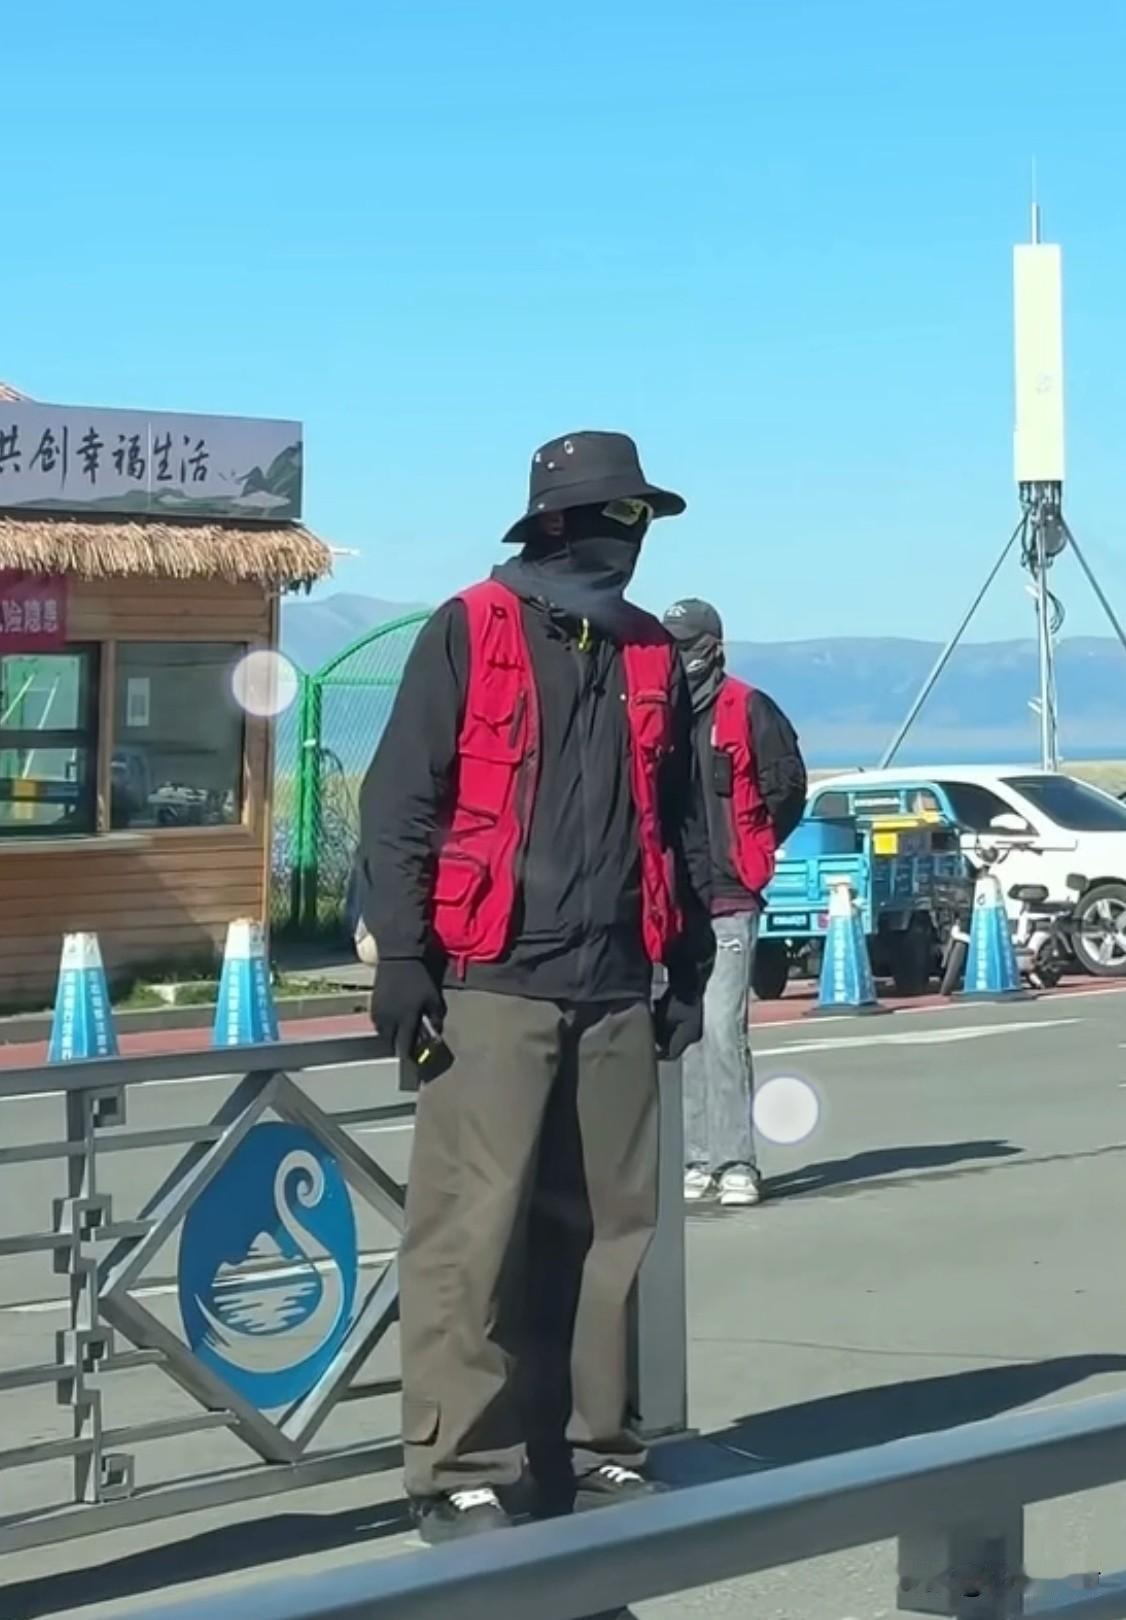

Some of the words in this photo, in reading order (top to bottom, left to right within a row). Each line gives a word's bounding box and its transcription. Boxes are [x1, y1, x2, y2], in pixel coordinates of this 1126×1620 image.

[0, 424, 210, 490] 共创幸福生活
[0, 599, 58, 633] 险隐患
